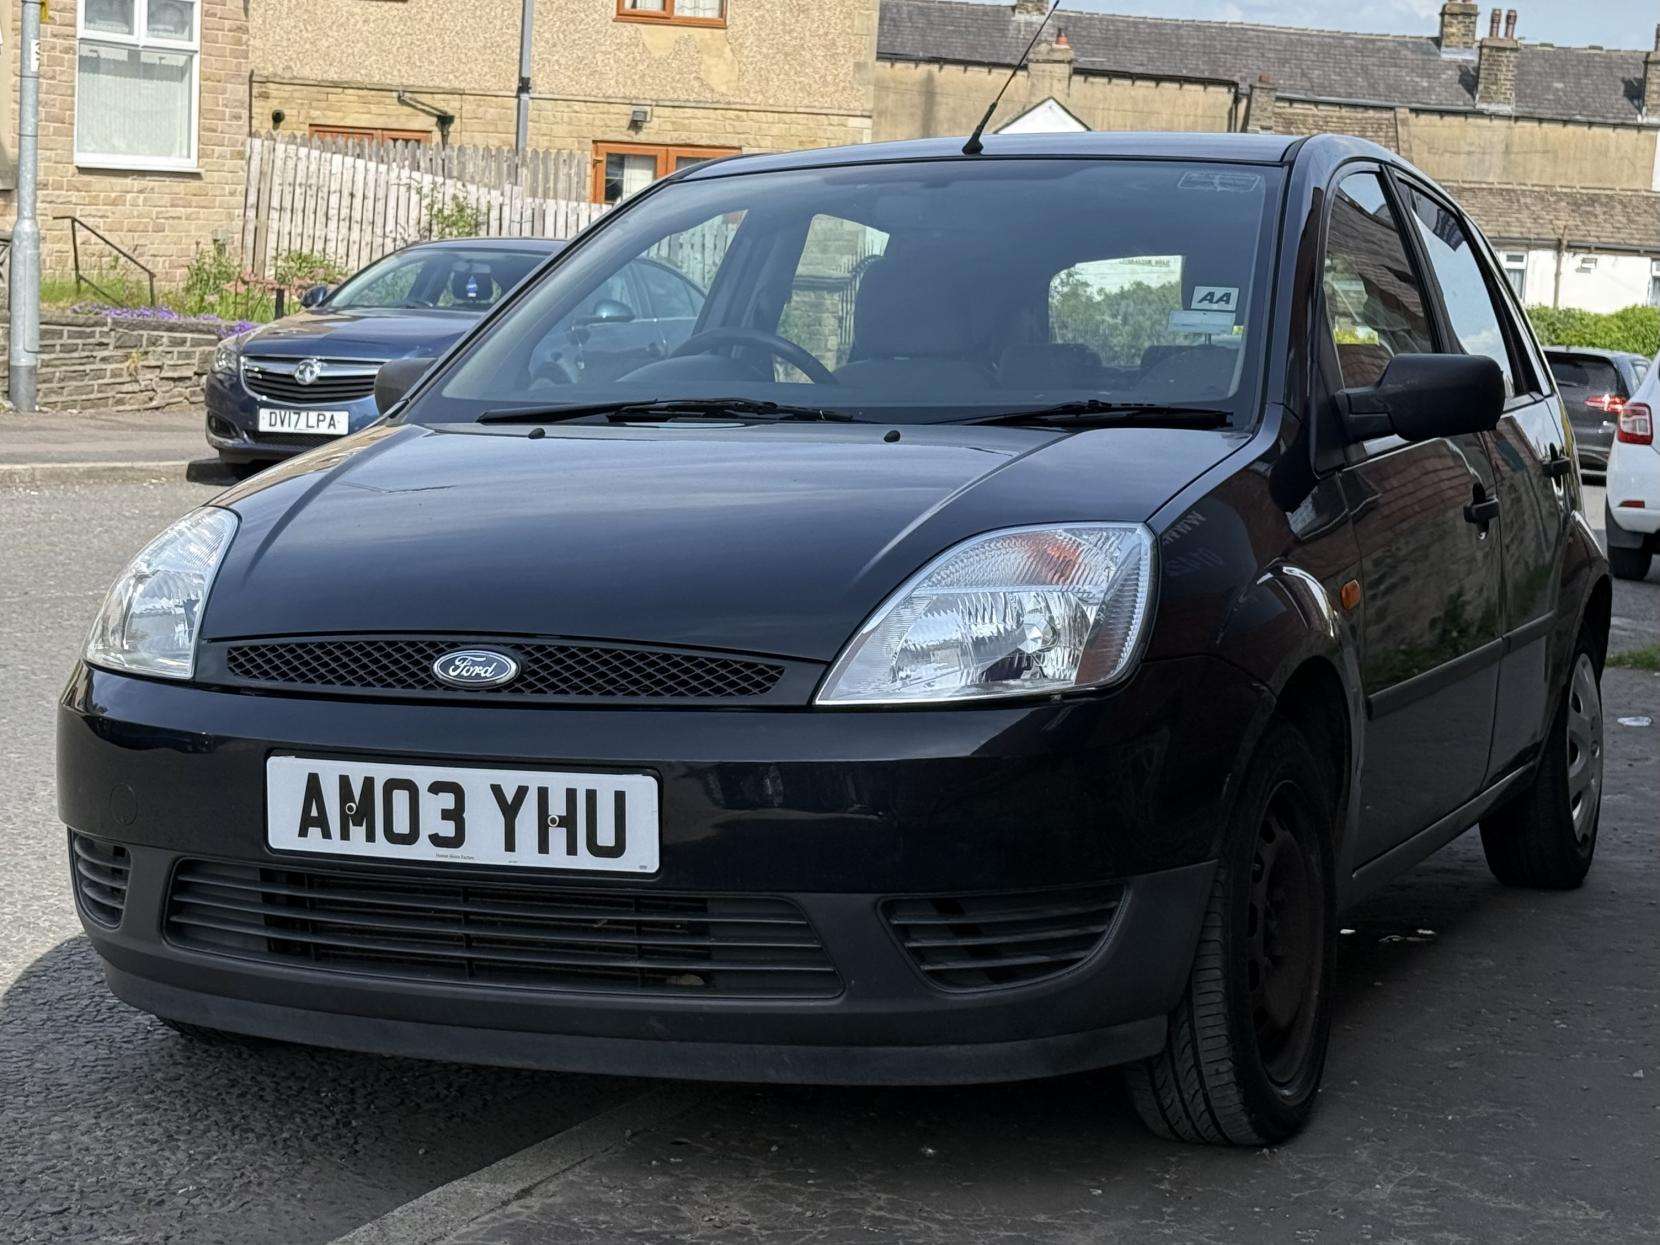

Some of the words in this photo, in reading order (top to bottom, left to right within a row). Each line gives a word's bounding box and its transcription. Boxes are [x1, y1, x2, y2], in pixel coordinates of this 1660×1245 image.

[1197, 291, 1232, 305] AA
[269, 411, 301, 429] DV17
[305, 411, 337, 430] LPA
[449, 656, 497, 677] Ford
[298, 772, 466, 850] AM03
[489, 783, 627, 859] YHU
